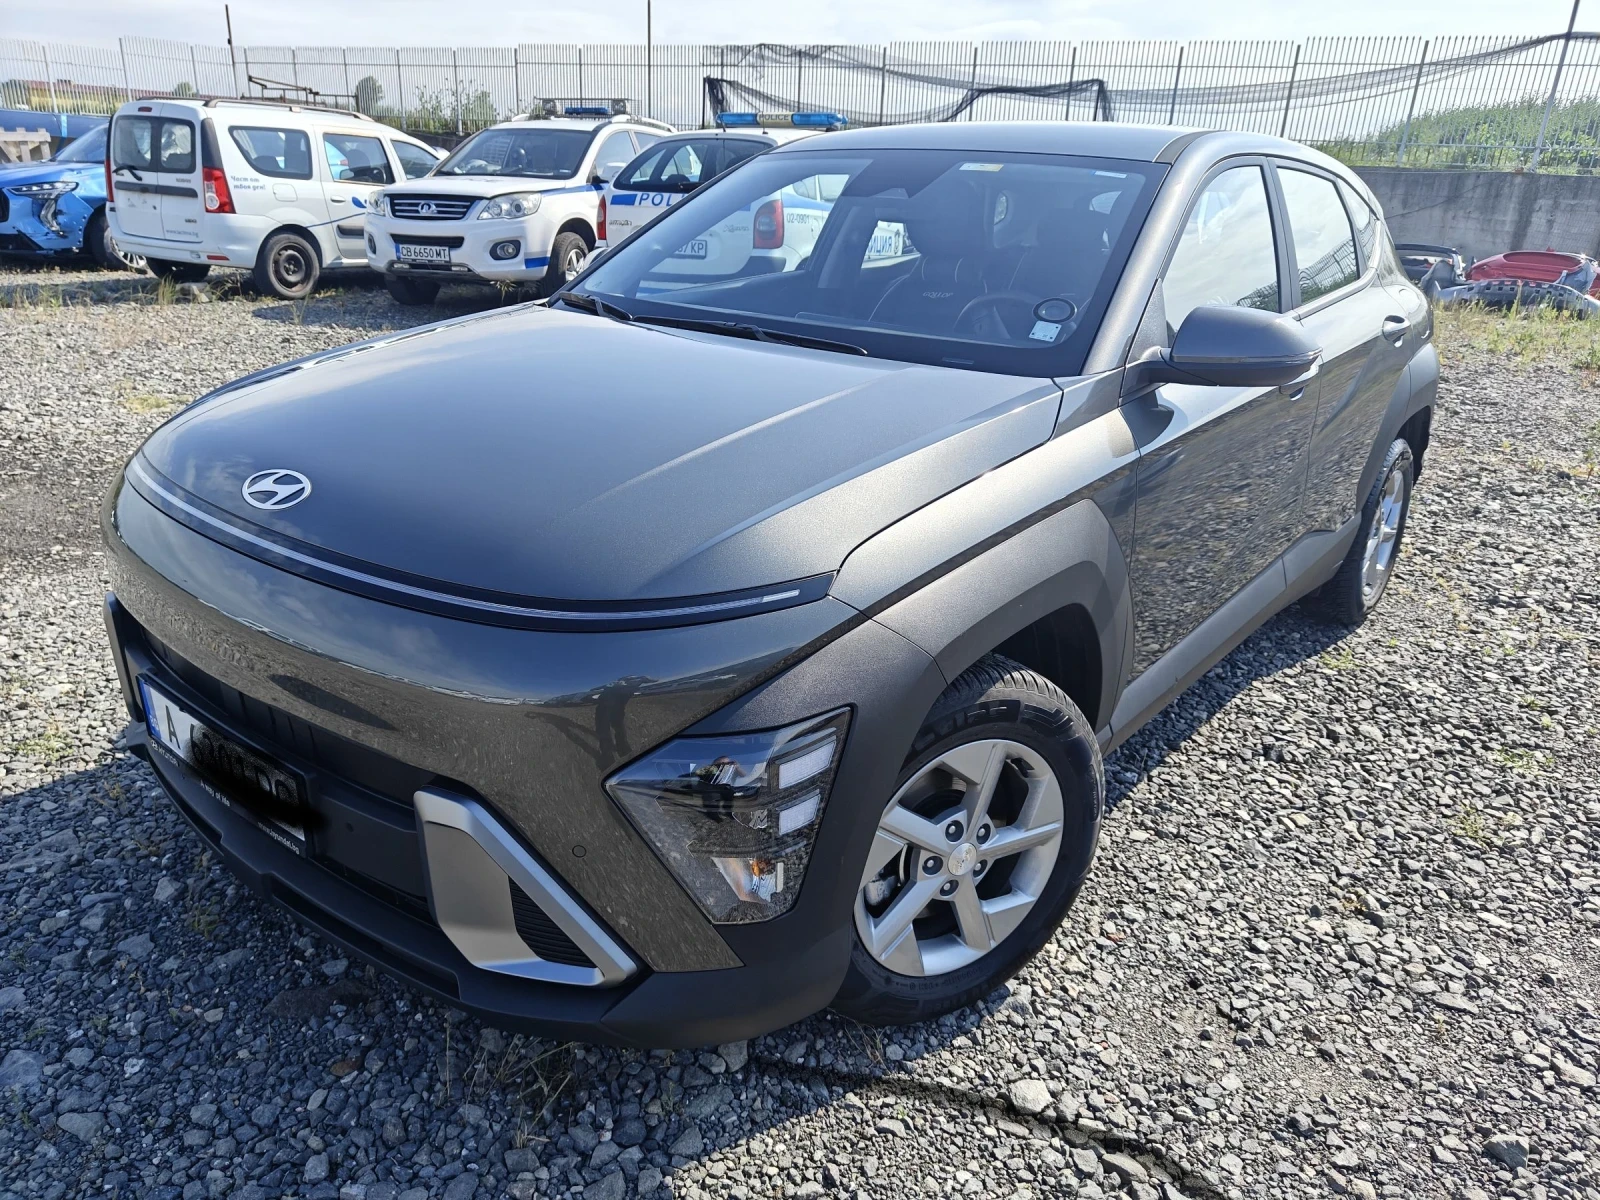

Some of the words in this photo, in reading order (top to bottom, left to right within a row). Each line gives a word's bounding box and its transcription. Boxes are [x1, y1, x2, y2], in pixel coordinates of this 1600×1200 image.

[759, 113, 789, 121] POLICE
[639, 192, 685, 207] POL
[786, 212, 810, 224] 02-0901
[401, 246, 413, 257] CB
[413, 247, 435, 258] 6650
[435, 248, 447, 259] MT
[690, 242, 705, 254] KP
